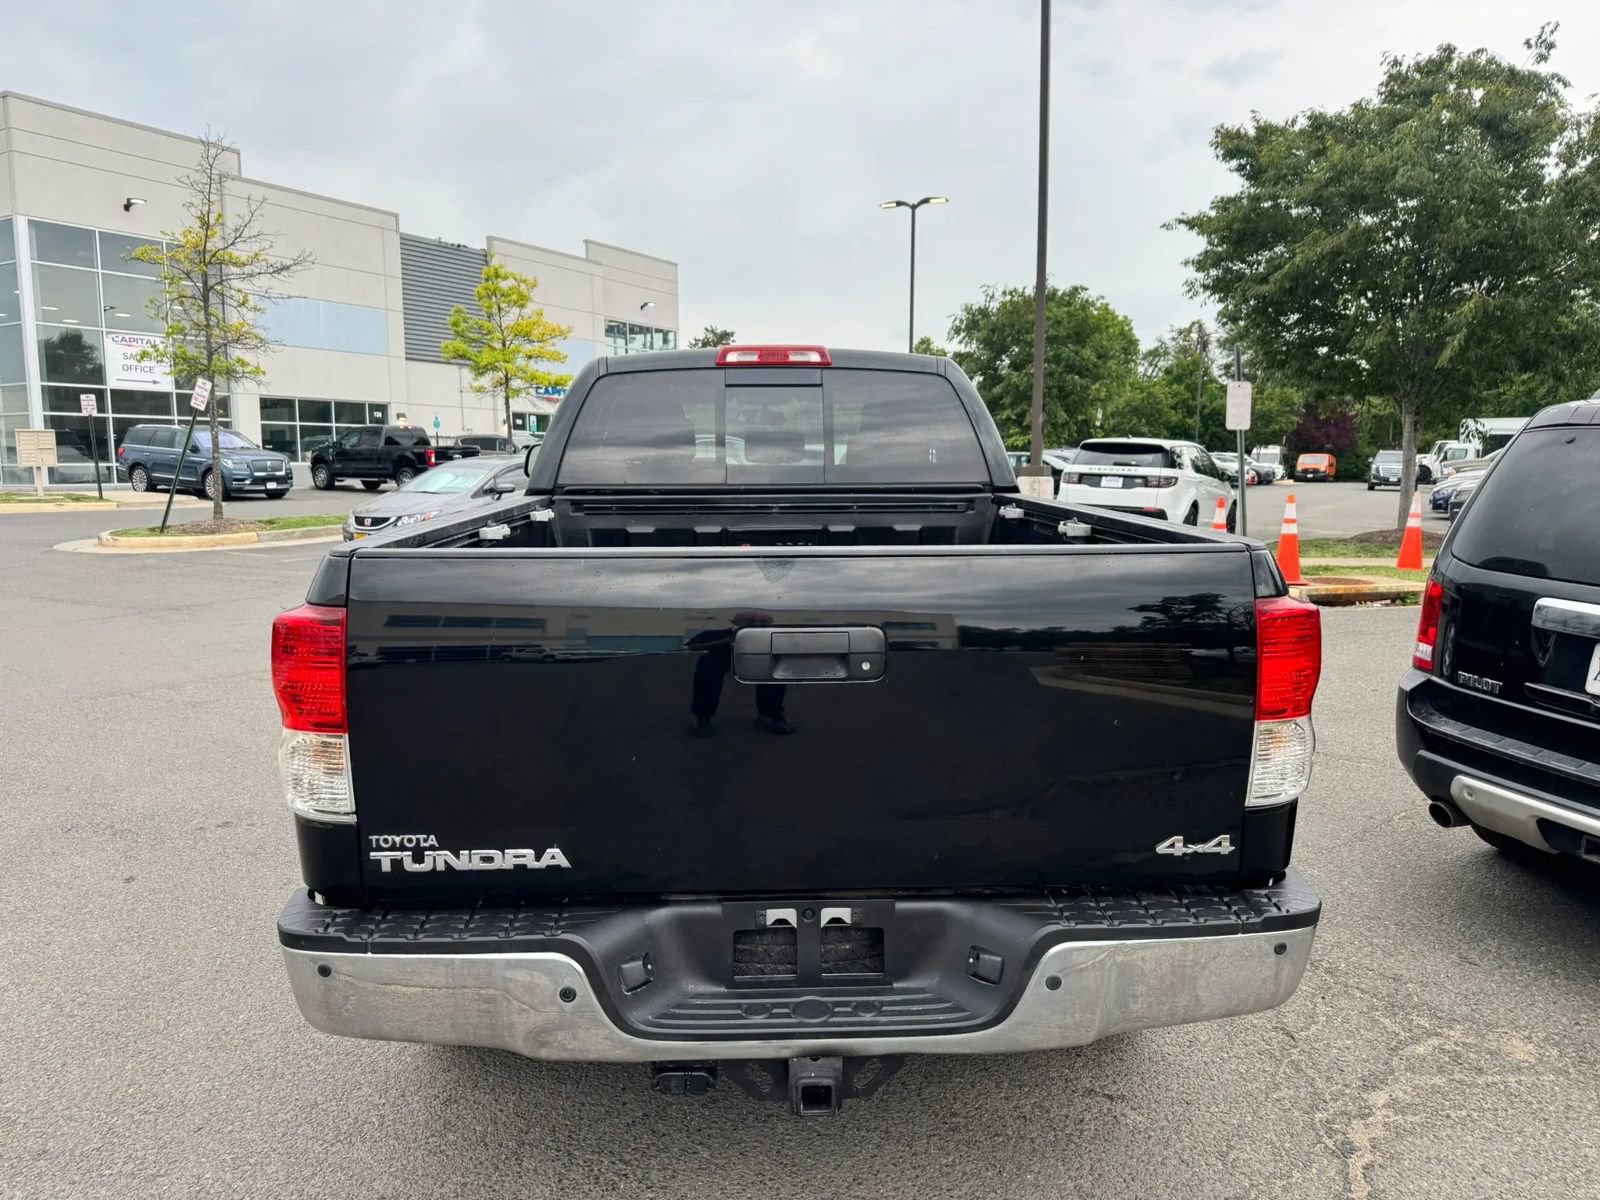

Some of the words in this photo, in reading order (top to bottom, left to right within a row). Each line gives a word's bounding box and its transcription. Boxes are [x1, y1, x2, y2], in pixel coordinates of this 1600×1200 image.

[111, 335, 157, 347] CAPITAL
[122, 364, 155, 374] OFFICE
[1457, 671, 1503, 695] PILOT
[368, 834, 439, 848] TOYOTA
[1155, 834, 1236, 856] 4x4
[369, 848, 572, 873] TUNDRA
